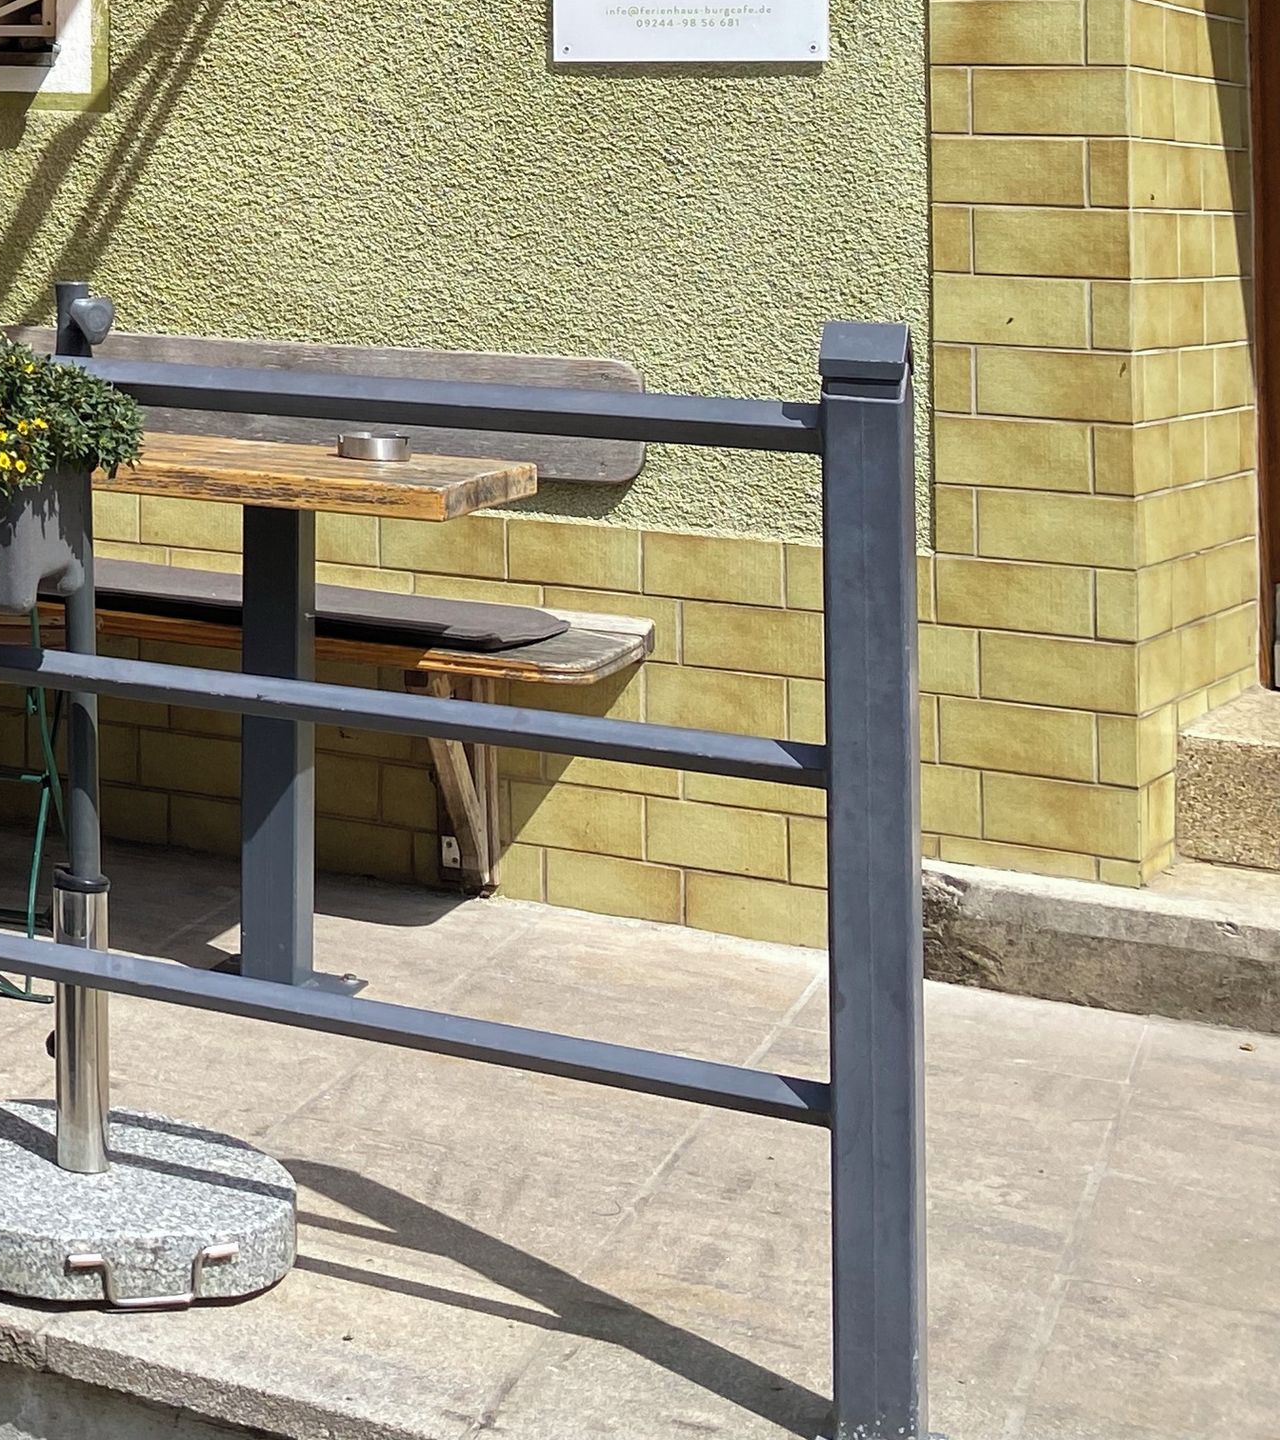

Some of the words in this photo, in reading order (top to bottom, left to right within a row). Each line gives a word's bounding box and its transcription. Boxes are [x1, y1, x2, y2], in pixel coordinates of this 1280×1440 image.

[605, 4, 773, 17] info@ferienhaus-burgcafe.de
[700, 18, 716, 28] 56
[719, 17, 741, 28] 681
